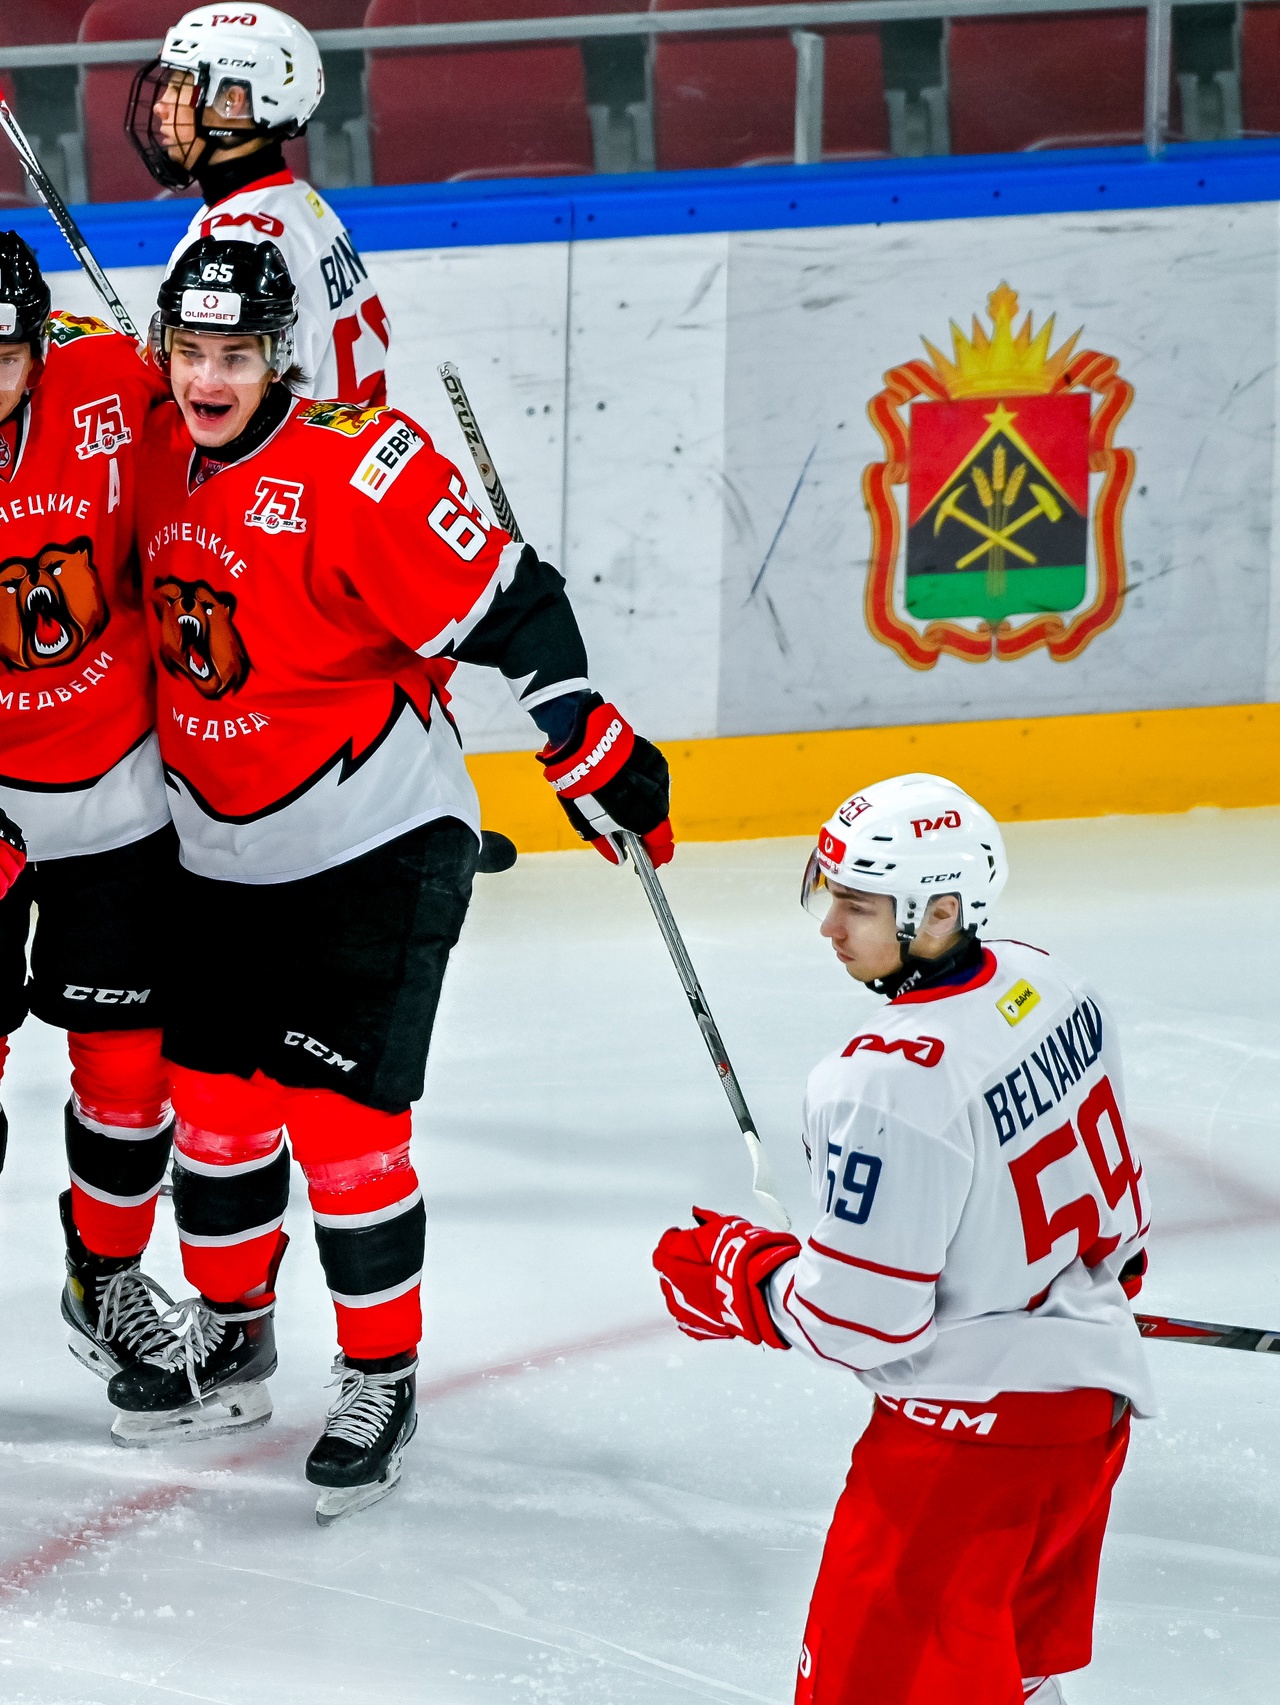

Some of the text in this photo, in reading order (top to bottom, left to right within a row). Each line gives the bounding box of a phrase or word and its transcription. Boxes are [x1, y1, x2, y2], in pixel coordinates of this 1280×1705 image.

[217, 57, 257, 69] CCM
[201, 263, 234, 283] 65
[185, 311, 236, 321] OLIMPBET
[254, 476, 304, 521] 75
[427, 474, 491, 562] 65
[147, 522, 248, 579] КУЗНЕЦКИЕ
[548, 718, 623, 792] HER-WOOD
[839, 796, 873, 822] 59
[920, 871, 962, 883] CCM
[63, 984, 151, 1004] CCM
[1015, 987, 1033, 1007] БАНК
[284, 1031, 358, 1072] CCM
[983, 995, 1103, 1147] BELYAKOV
[1008, 1074, 1142, 1311] 59
